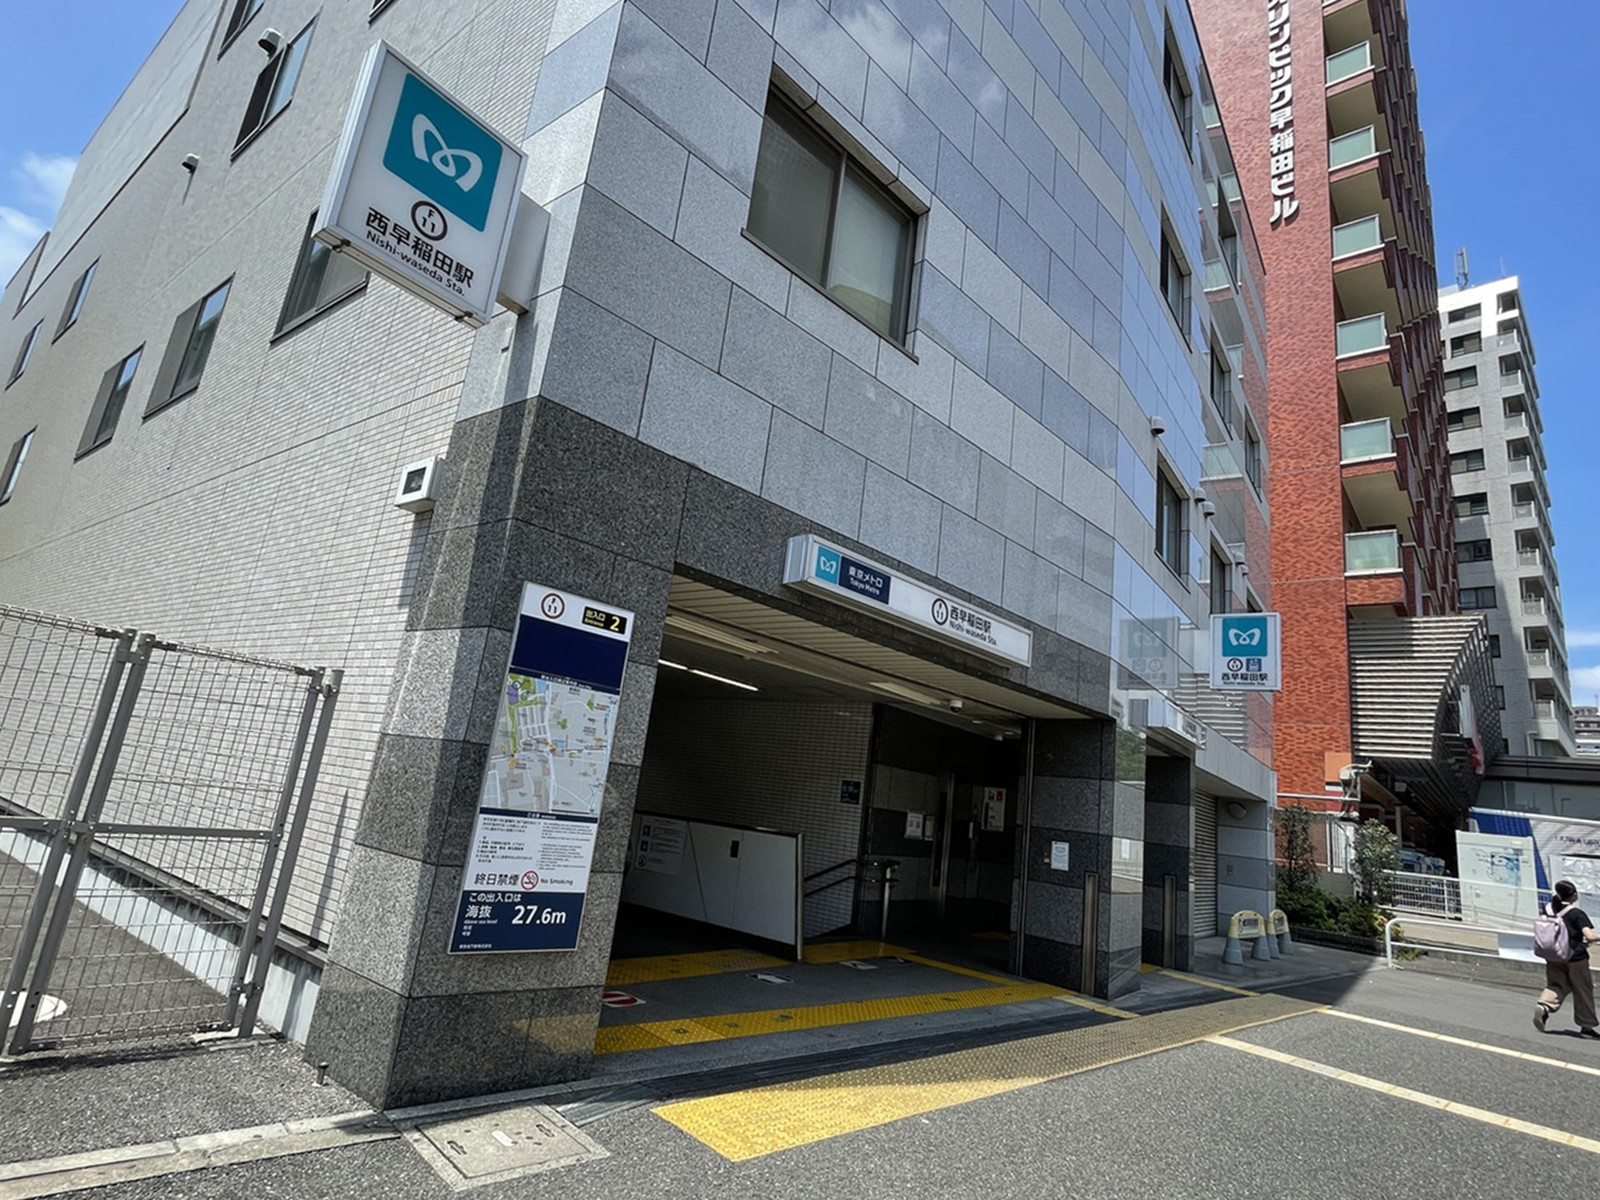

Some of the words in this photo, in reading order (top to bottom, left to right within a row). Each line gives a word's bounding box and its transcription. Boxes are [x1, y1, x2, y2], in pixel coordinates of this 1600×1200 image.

[427, 208, 435, 218] F
[421, 216, 437, 233] 11
[365, 206, 474, 289] 西早稲田駅
[366, 230, 443, 283] Nishi-waseda
[445, 277, 465, 297] Sta.
[848, 566, 883, 588] 東京メトロ
[609, 615, 621, 632] 2
[950, 605, 992, 634] 西早稲田駅
[474, 872, 520, 886] 終日禁煙
[549, 877, 574, 886] Smoking
[468, 892, 522, 903] この出入口は
[464, 904, 493, 919] 海抜
[511, 904, 567, 925] 27.6m
